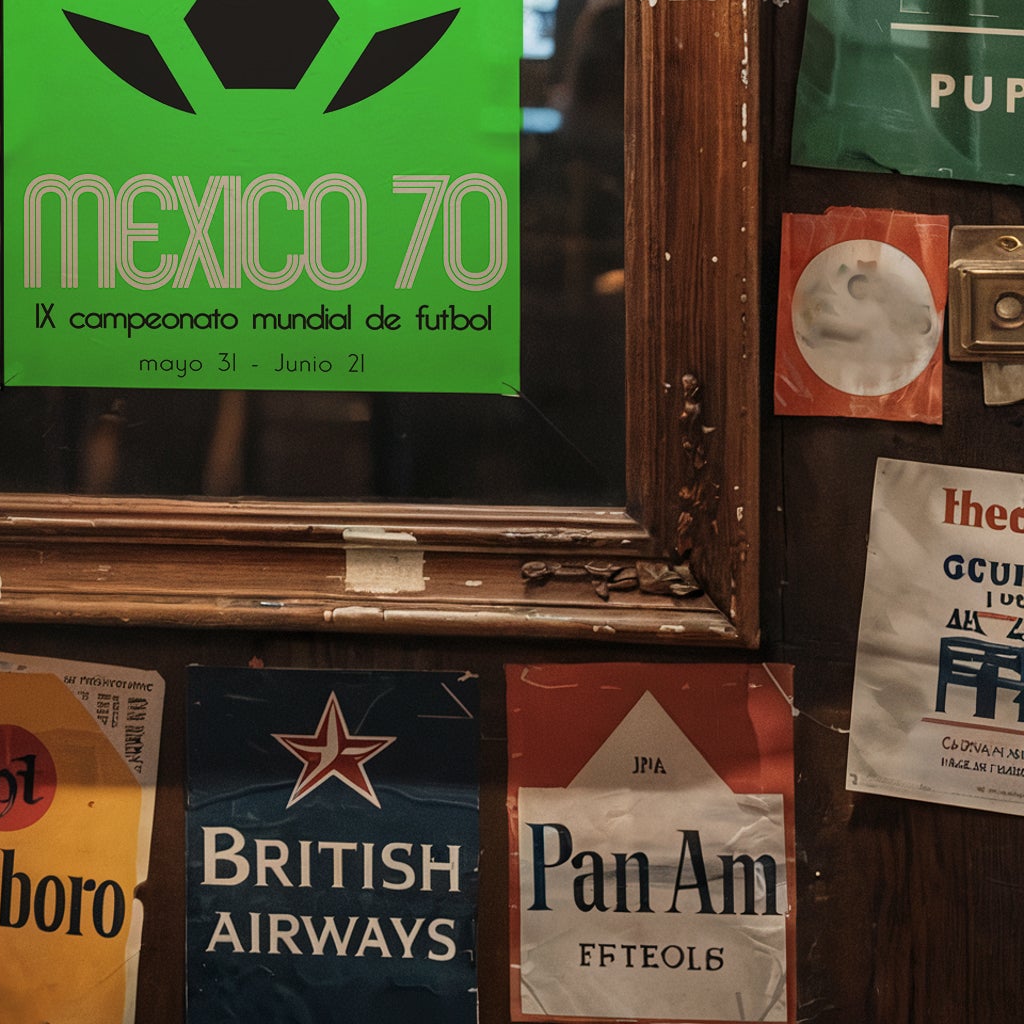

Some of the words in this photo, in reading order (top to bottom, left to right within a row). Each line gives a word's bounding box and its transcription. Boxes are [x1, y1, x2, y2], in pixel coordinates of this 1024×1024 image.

[24, 173, 367, 291] MEXICO
[393, 173, 508, 291] 70
[35, 303, 56, 329] IX
[69, 309, 239, 338] campeonato
[252, 304, 352, 331] mundial
[365, 304, 402, 330] de
[416, 304, 493, 331] futbol
[139, 357, 203, 378] mayo
[218, 352, 236, 372] 31
[274, 352, 333, 373] Junio
[348, 354, 365, 373] 21
[200, 826, 462, 893] BRITISH
[525, 822, 656, 913] Pan
[669, 829, 784, 916] Am
[205, 912, 457, 962] AIRWAYS
